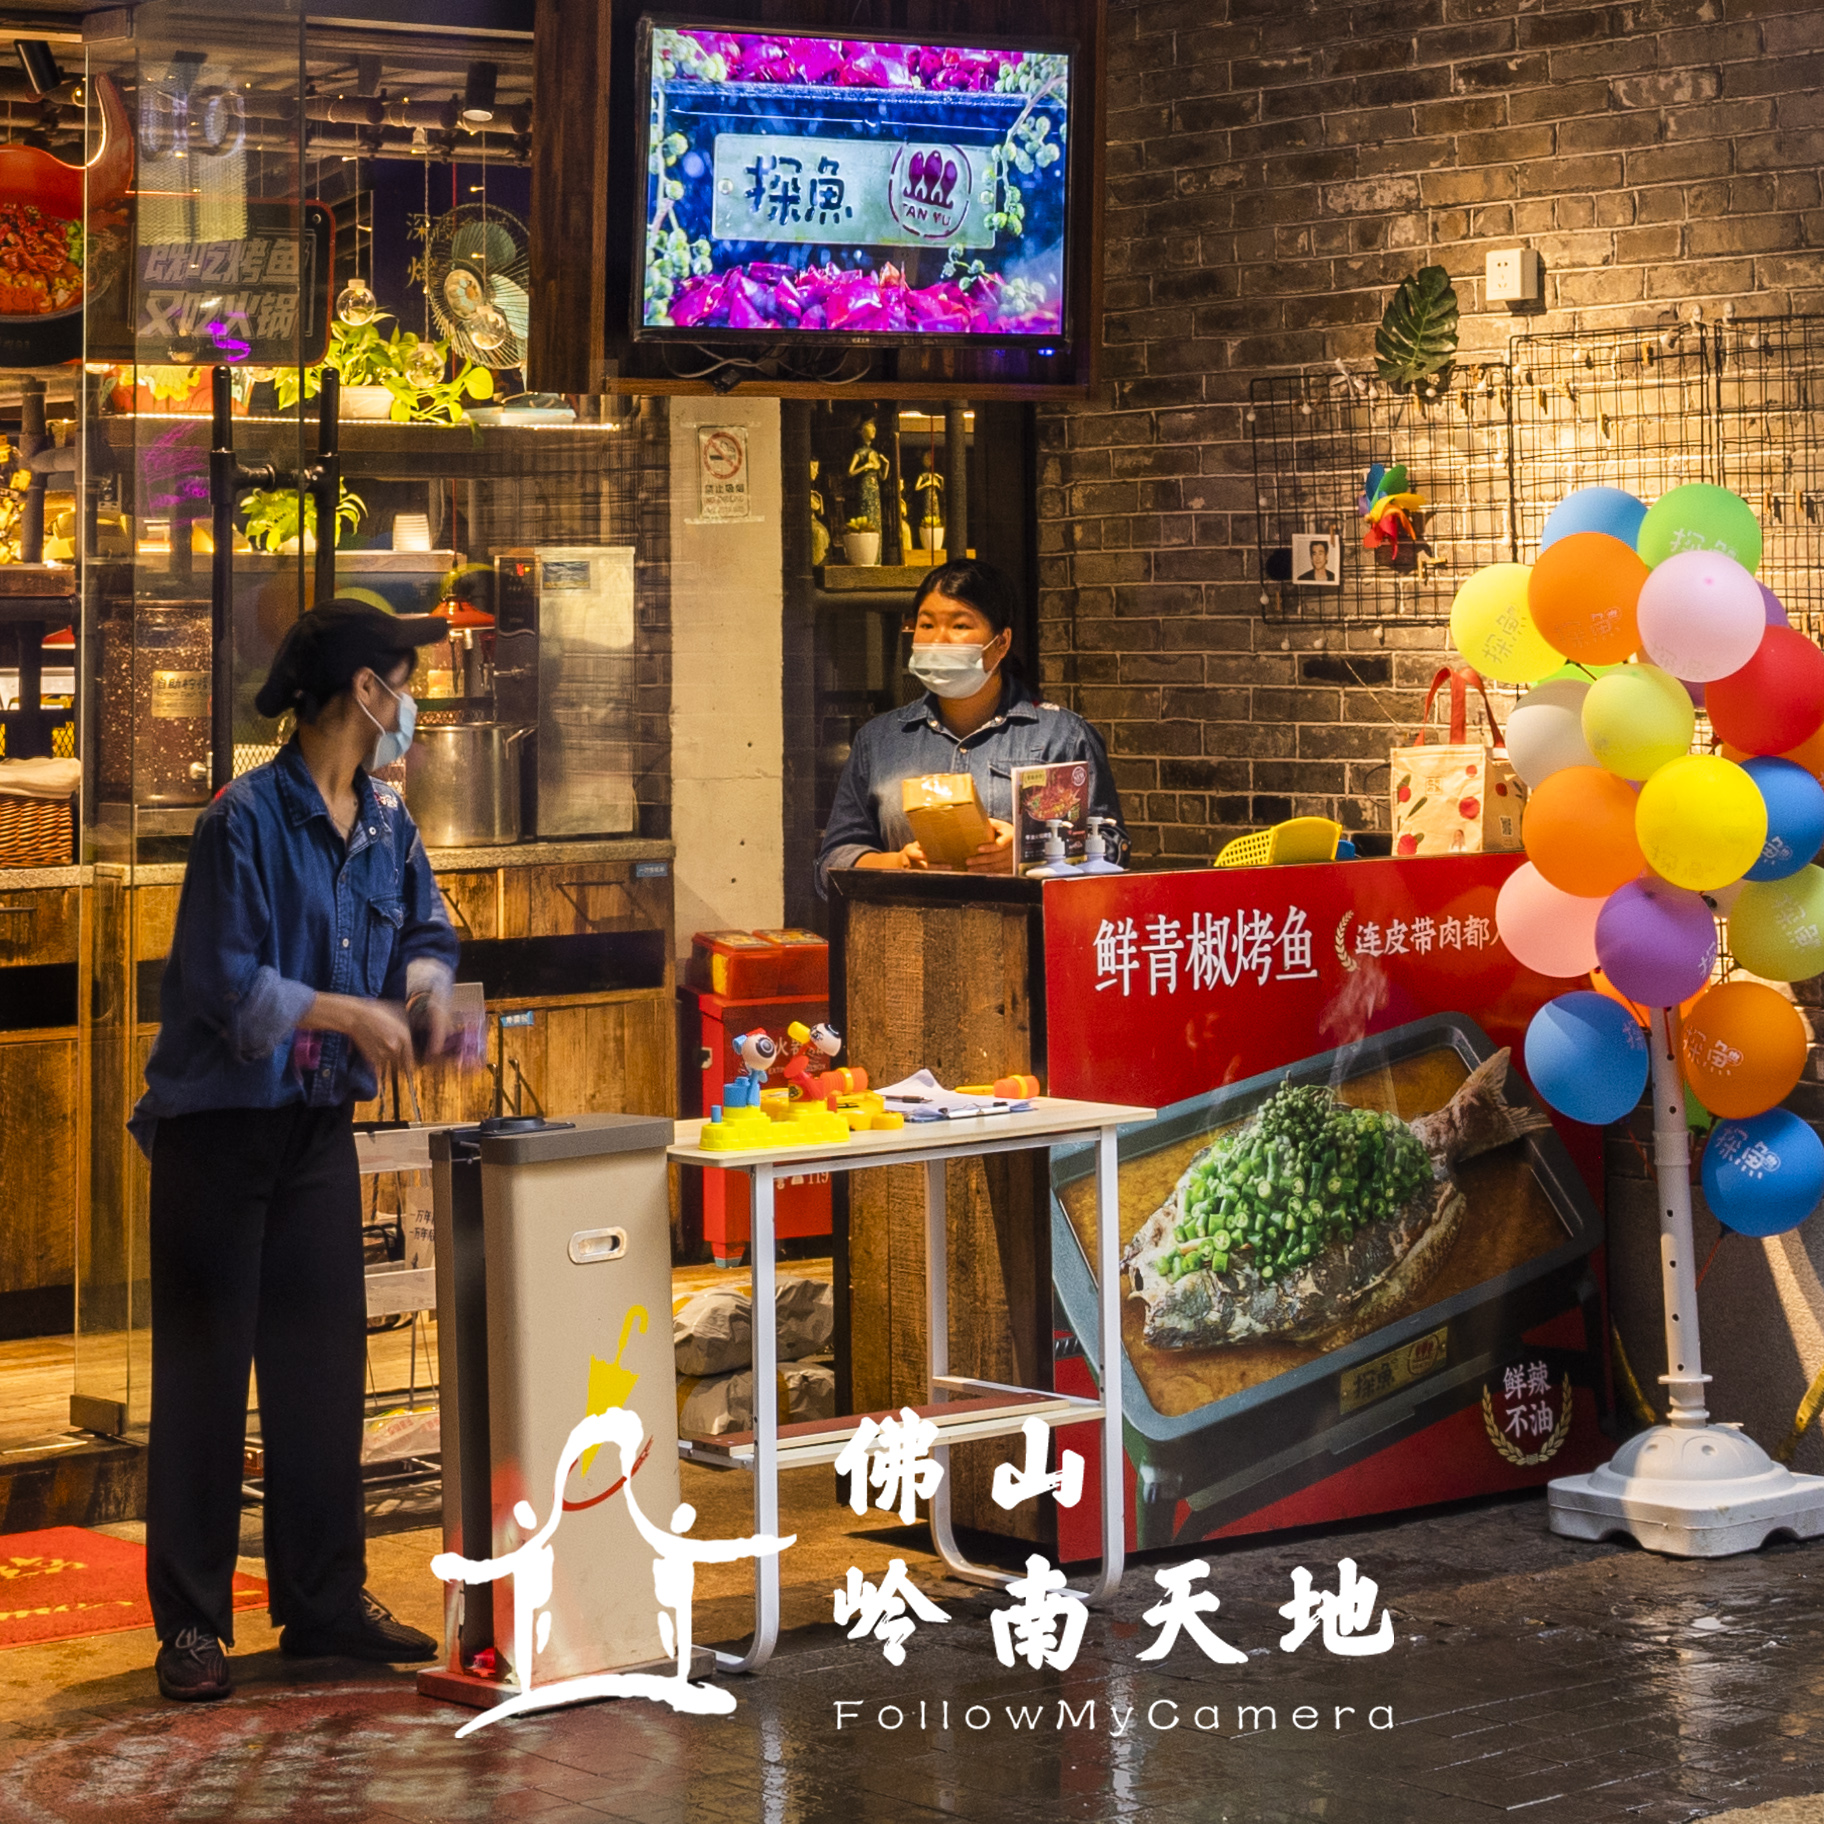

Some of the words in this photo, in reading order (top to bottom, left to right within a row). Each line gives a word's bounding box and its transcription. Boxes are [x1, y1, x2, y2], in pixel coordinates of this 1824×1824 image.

[902, 202, 928, 221] TAN
[932, 212, 951, 227] YU
[1093, 904, 1319, 997] 鲜青椒烤鱼
[1502, 1360, 1552, 1401] 鲜辣
[1504, 1400, 1554, 1439] 不油
